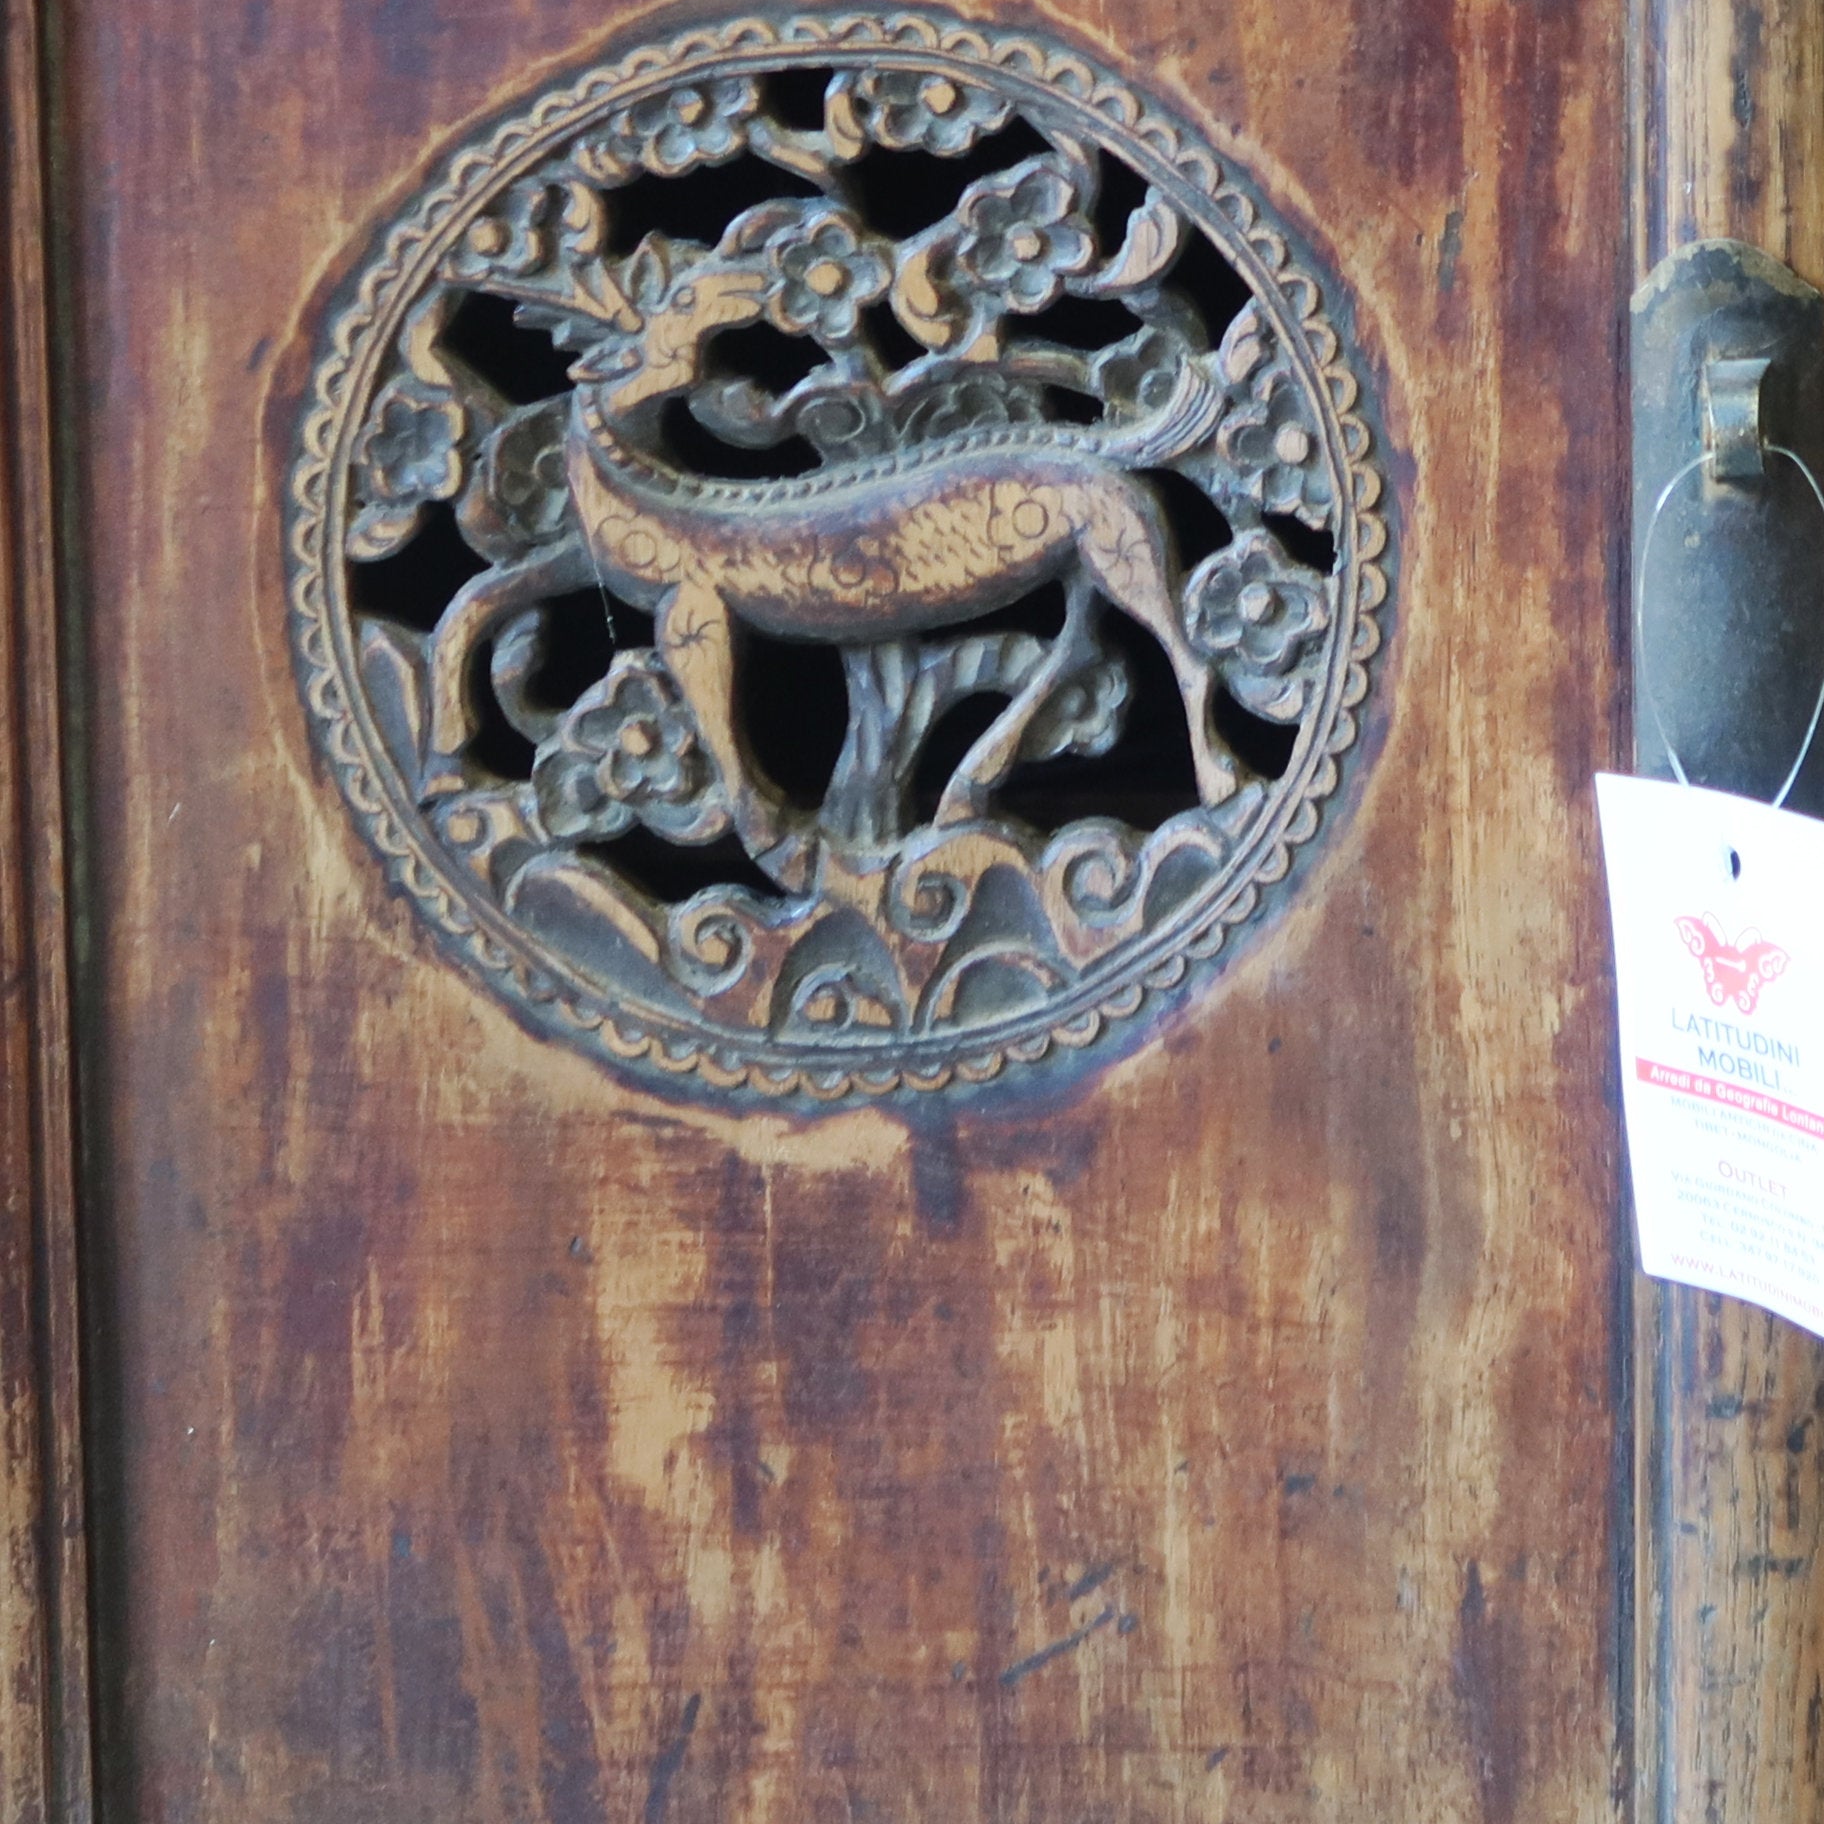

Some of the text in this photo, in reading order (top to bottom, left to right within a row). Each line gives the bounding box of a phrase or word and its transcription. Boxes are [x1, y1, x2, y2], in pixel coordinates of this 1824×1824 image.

[1672, 1007, 1800, 1067] LATITUDINI
[1650, 1066, 1690, 1088] Arredi
[1694, 1079, 1711, 1094] da
[1716, 1084, 1778, 1116] Geografie
[1718, 1160, 1788, 1201] OUTLET
